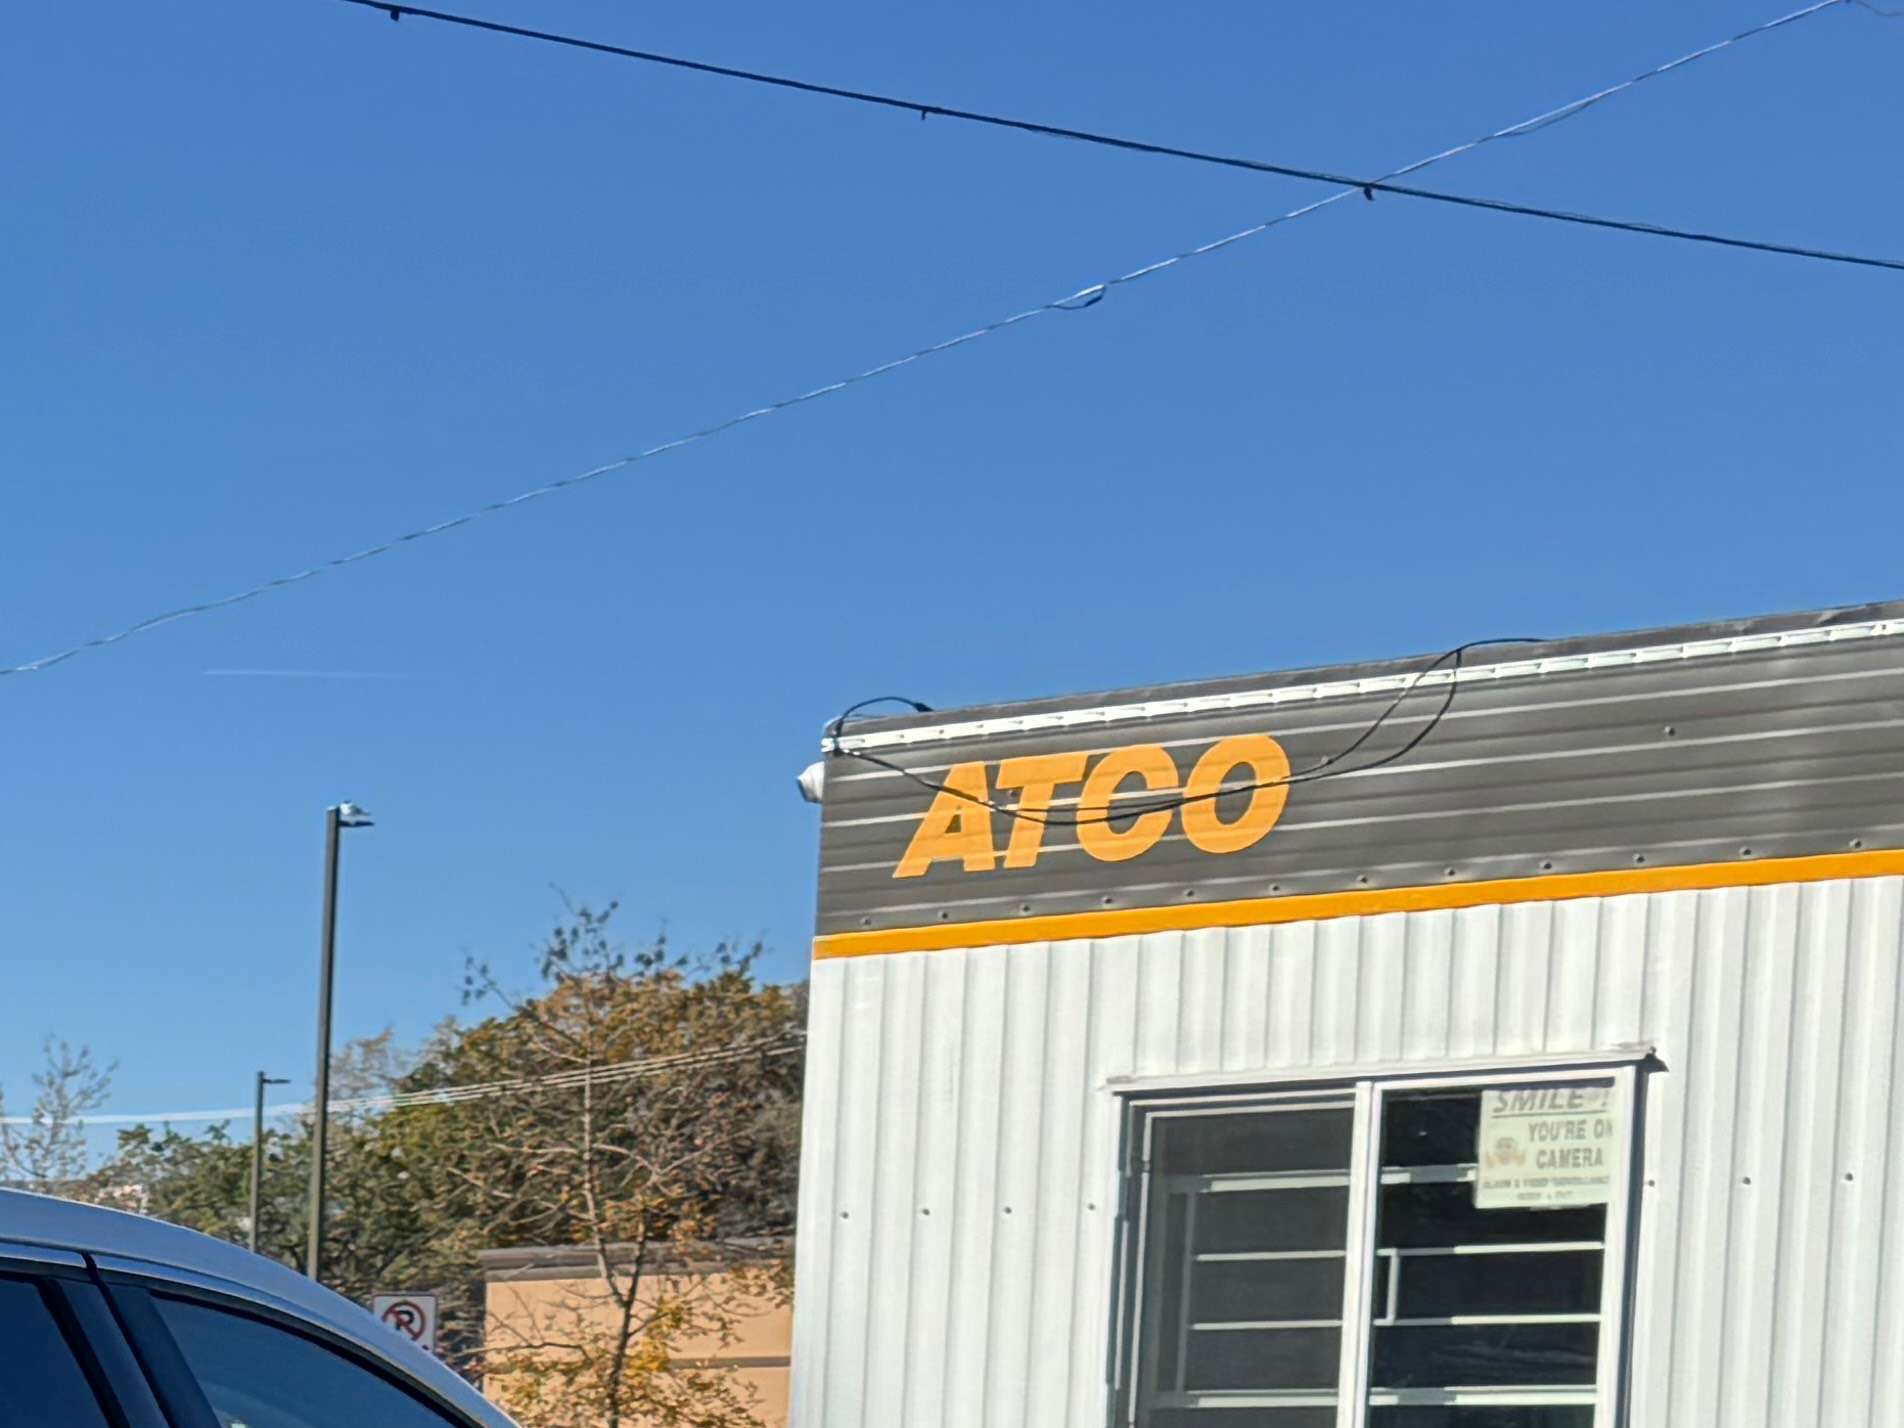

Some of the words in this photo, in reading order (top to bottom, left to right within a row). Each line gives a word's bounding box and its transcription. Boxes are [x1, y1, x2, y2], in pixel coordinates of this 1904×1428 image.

[893, 734, 1291, 879] ATCO
[1527, 1119, 1587, 1142] YOU'RE
[1535, 1147, 1604, 1170] CAMERA
